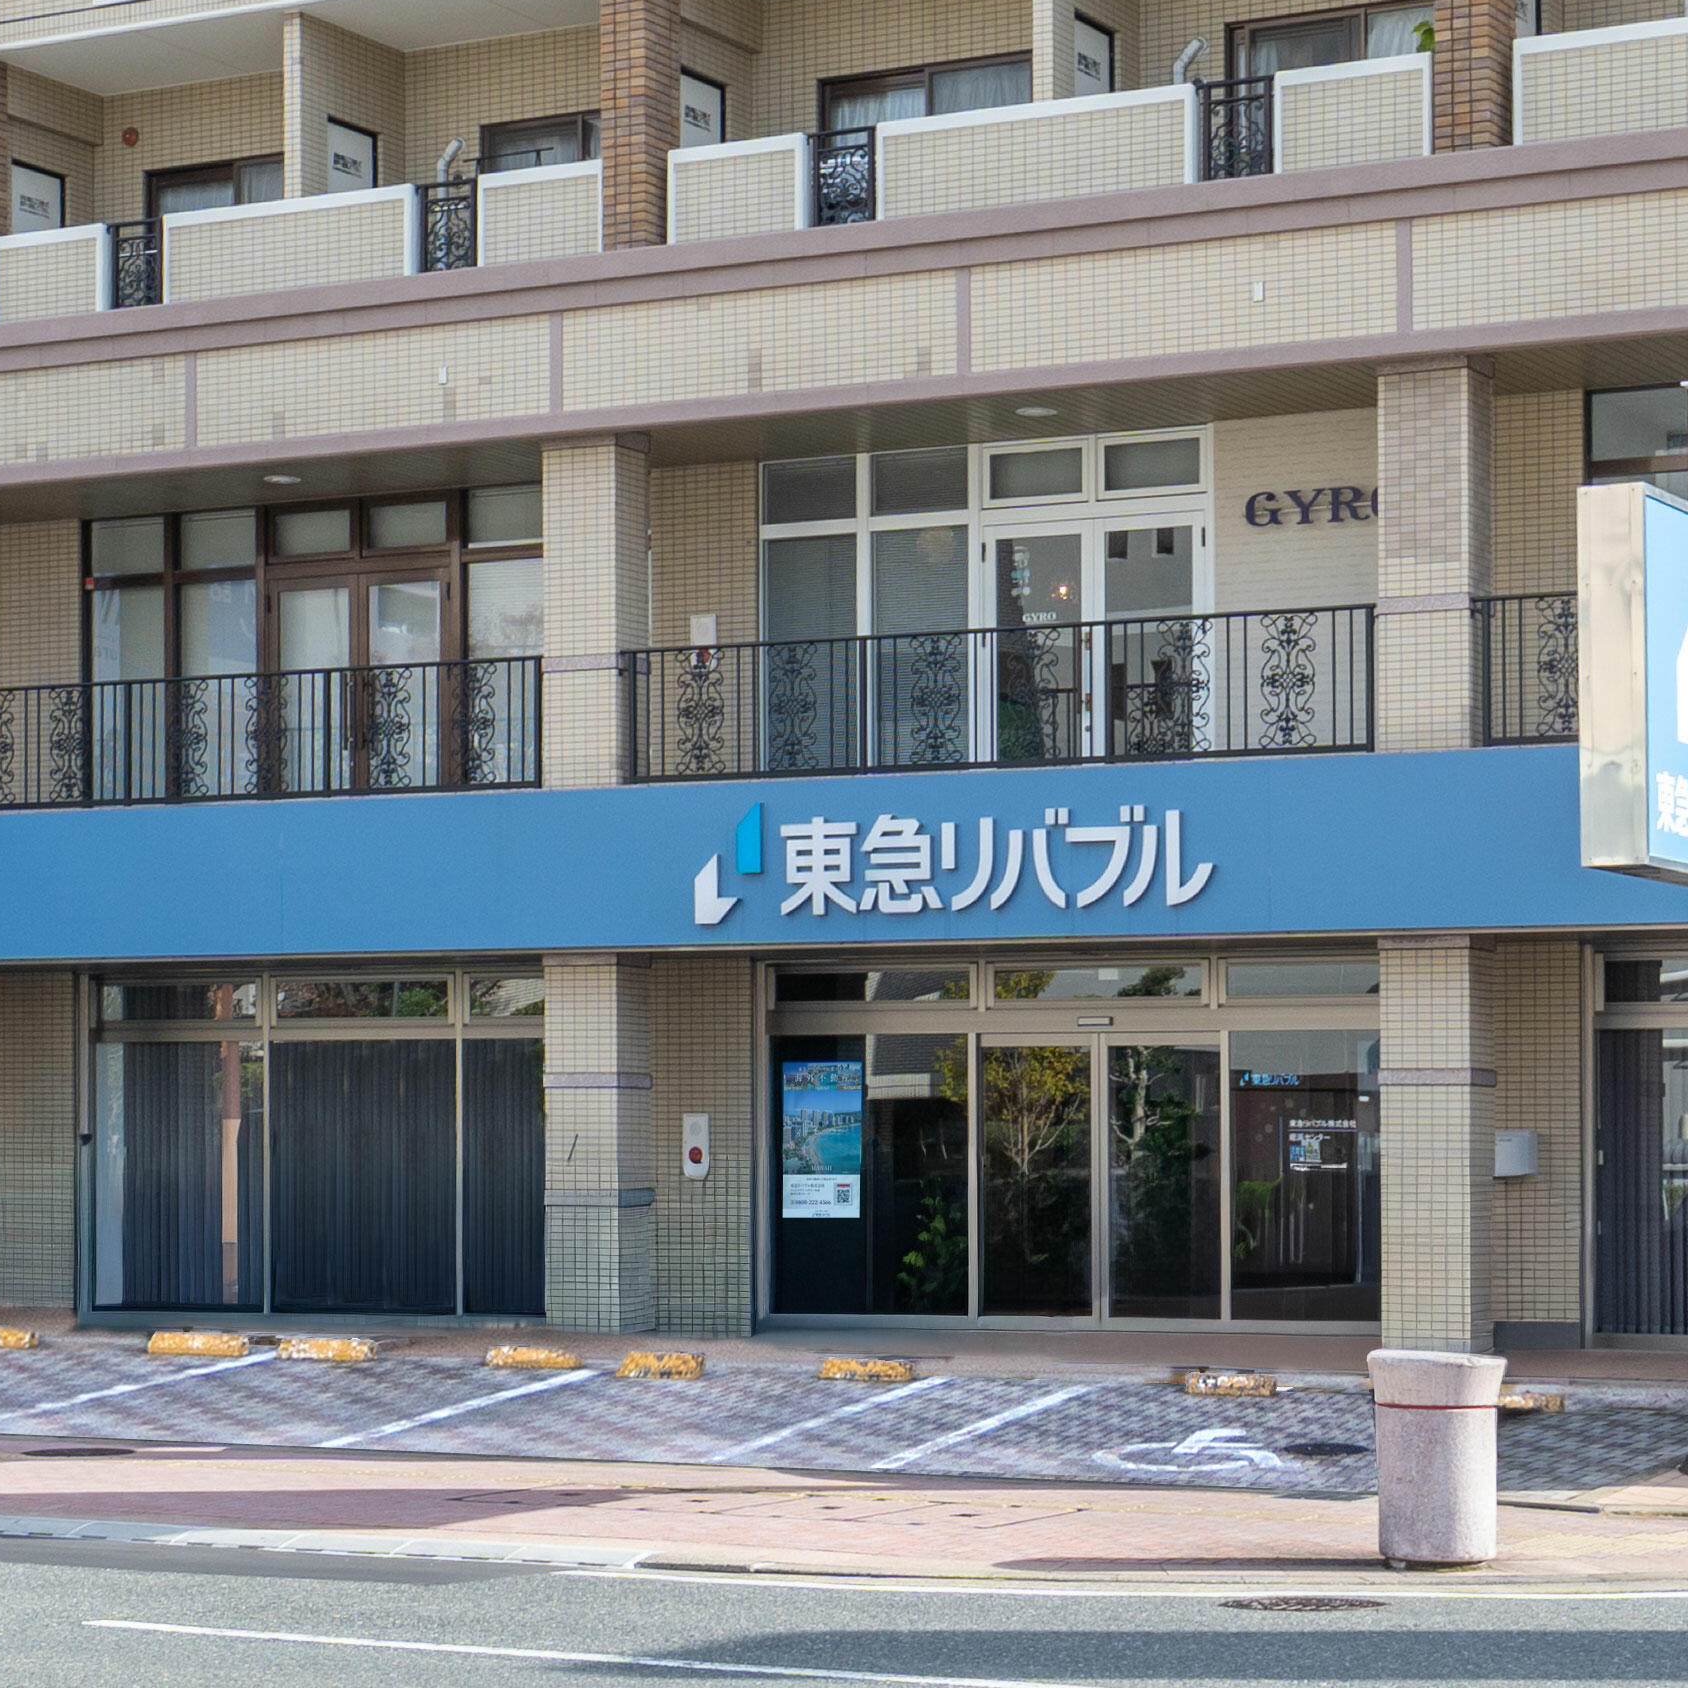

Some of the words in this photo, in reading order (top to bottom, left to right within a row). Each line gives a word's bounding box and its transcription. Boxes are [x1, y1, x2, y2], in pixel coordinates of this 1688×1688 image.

[1022, 611, 1057, 623] GYRO
[780, 805, 1214, 916] 東急リバブル
[1251, 1073, 1300, 1085] 東急リバブル
